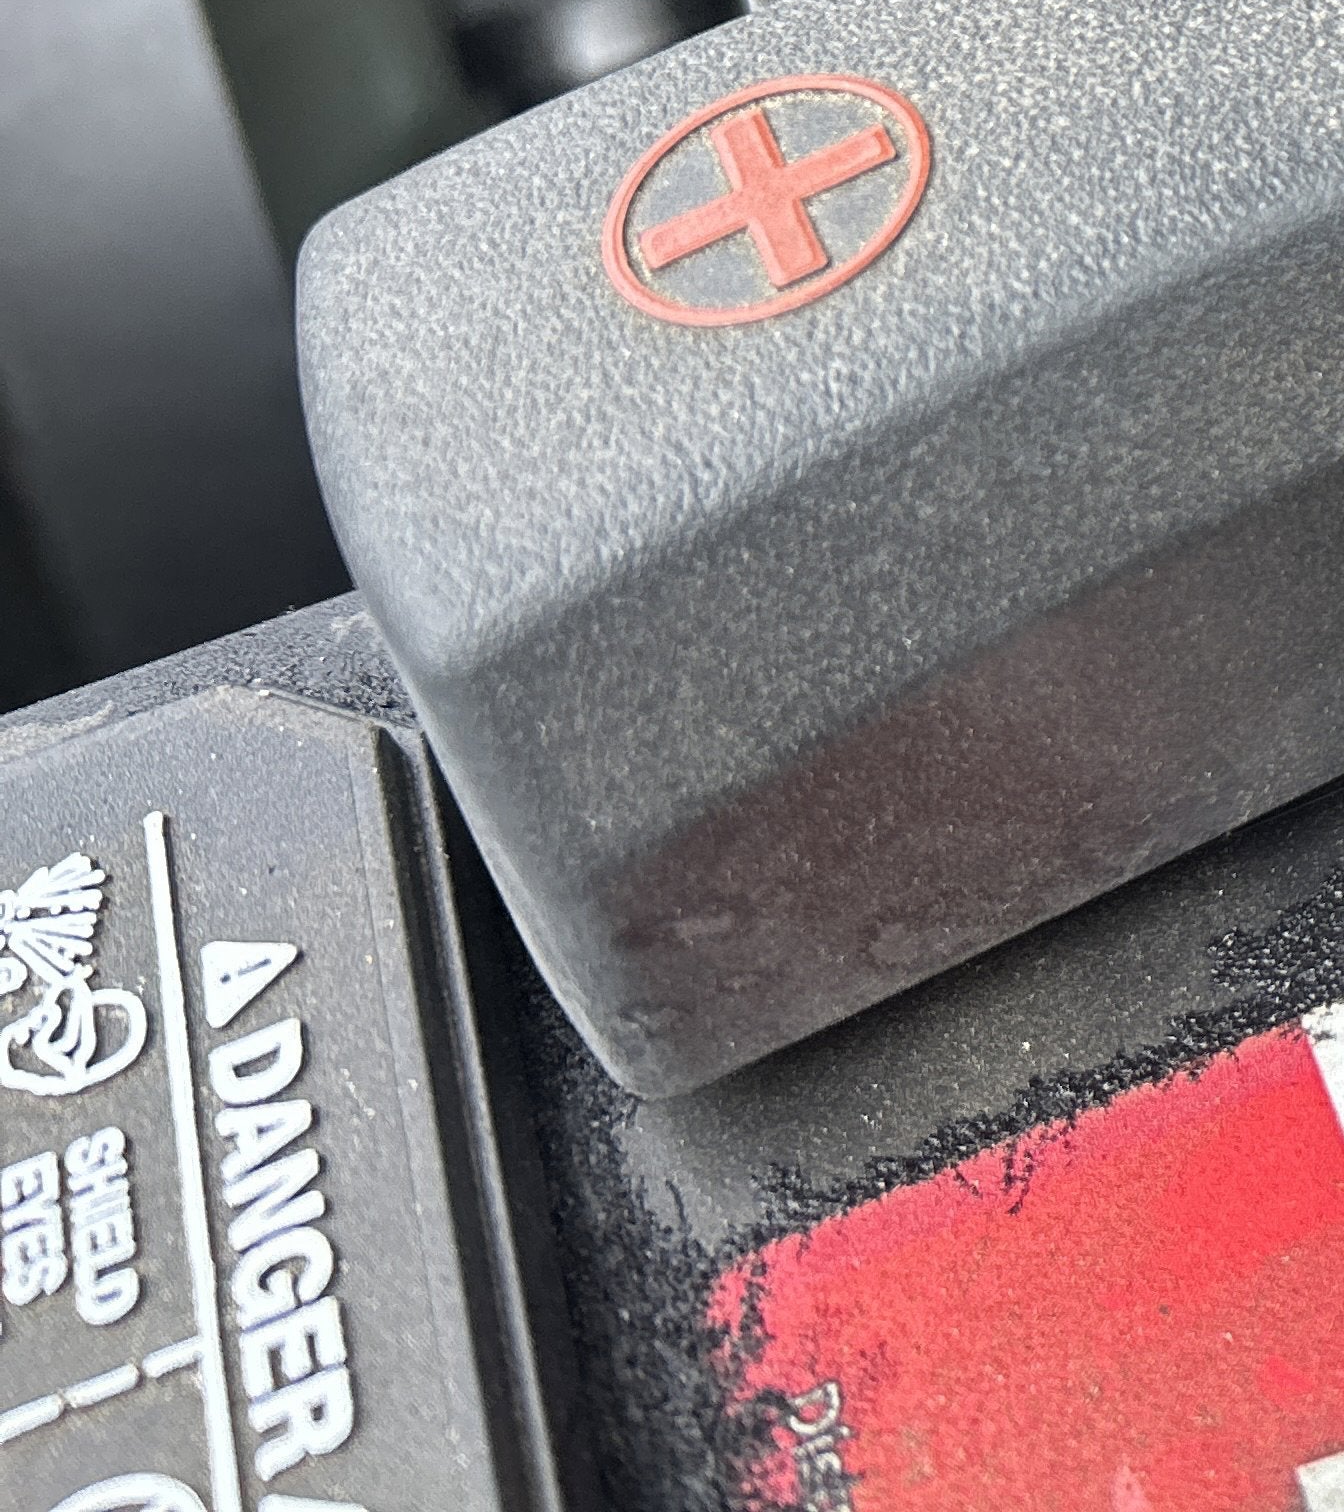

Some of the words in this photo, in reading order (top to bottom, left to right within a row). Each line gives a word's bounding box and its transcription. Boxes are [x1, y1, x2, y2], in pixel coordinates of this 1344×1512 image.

[0, 1150, 68, 1306] EYES
[64, 1126, 141, 1326] SHIELD
[208, 1017, 355, 1483] DANGER
